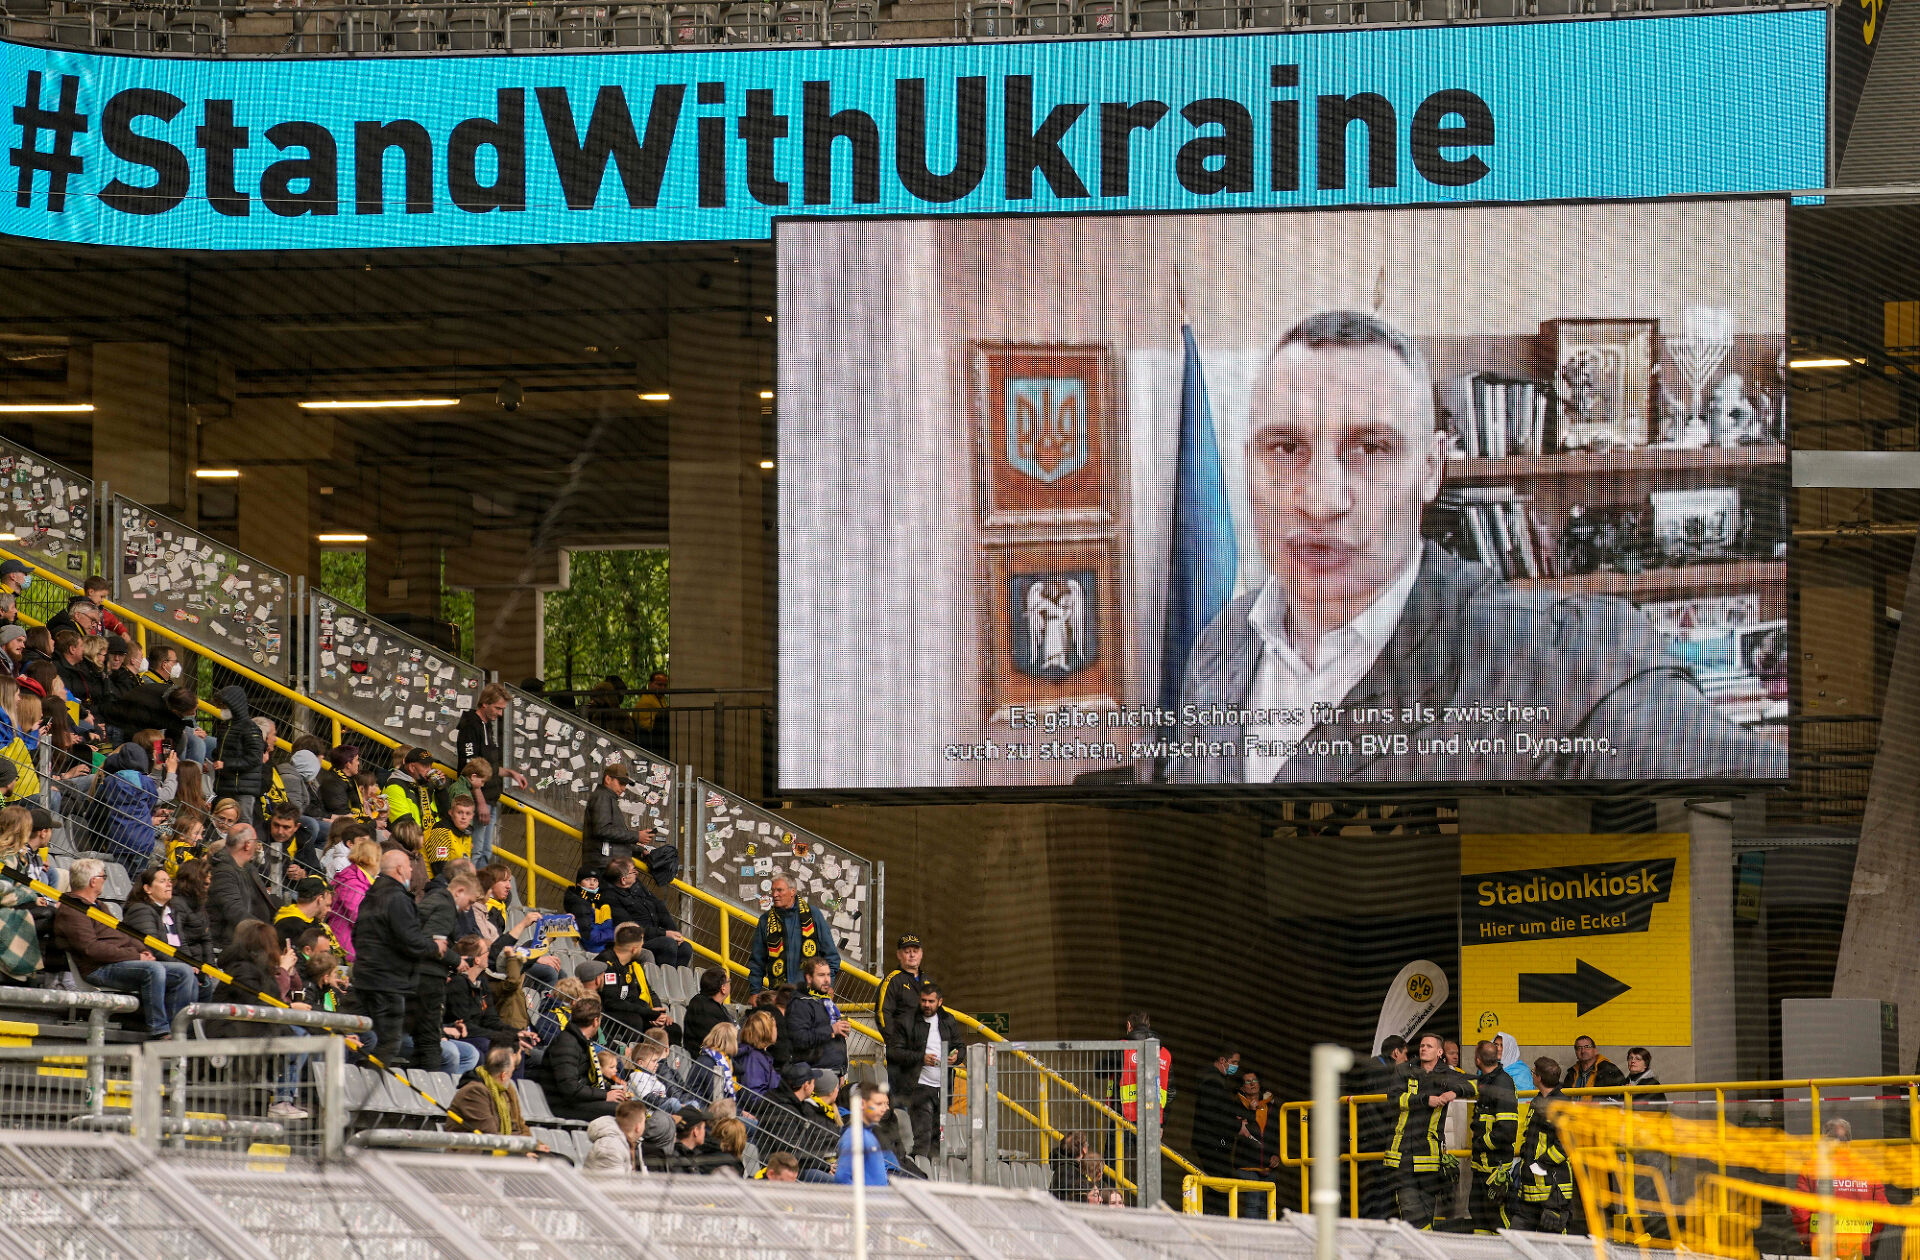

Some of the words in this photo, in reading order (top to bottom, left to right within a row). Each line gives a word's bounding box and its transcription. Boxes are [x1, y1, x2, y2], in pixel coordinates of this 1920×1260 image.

[10, 65, 1495, 217] #StandWithUkraine
[1010, 706, 1038, 728] Es
[1107, 704, 1176, 727] nichts
[1182, 704, 1305, 726] Schöneres
[1311, 702, 1346, 724] für
[1353, 708, 1395, 724] uns
[1401, 702, 1435, 723] als
[1442, 701, 1550, 723] zwischen
[944, 738, 999, 761] euch
[1006, 743, 1032, 760] zu
[1038, 737, 1124, 762] stehen,
[1130, 736, 1236, 758] zwischen
[1244, 735, 1298, 757] Fans
[1304, 741, 1354, 756] vom
[1361, 734, 1409, 755] BVB
[1417, 733, 1460, 755] und
[1466, 738, 1506, 754] von
[1516, 733, 1617, 759] Dynamo,
[1478, 868, 1659, 907] Stadionkiosk
[1480, 922, 1515, 938] Hier
[1520, 921, 1546, 935] um
[1551, 917, 1576, 932] die
[1581, 912, 1627, 930] Ecke!
[1410, 976, 1431, 996] BVB
